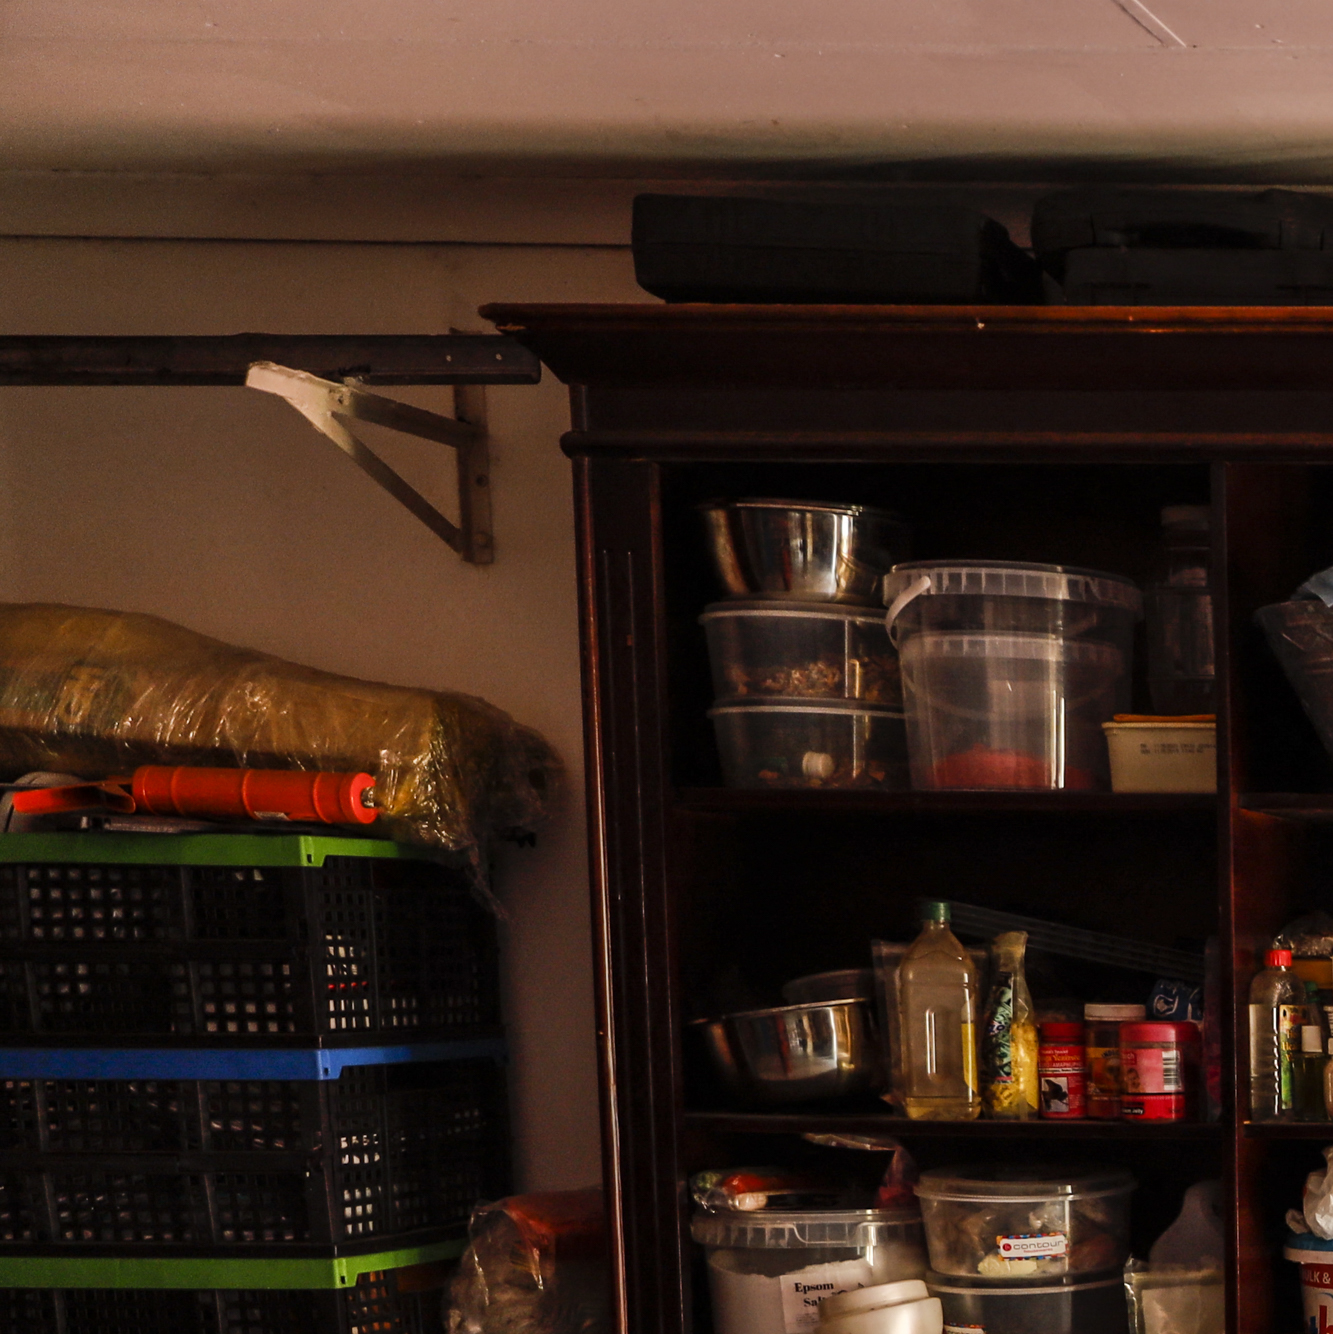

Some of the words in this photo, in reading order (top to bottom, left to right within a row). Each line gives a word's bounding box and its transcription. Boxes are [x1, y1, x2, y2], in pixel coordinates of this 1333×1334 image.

[1013, 1240, 1065, 1253] contour
[1322, 1273, 1332, 1284] &
[795, 1281, 836, 1297] Epsom
